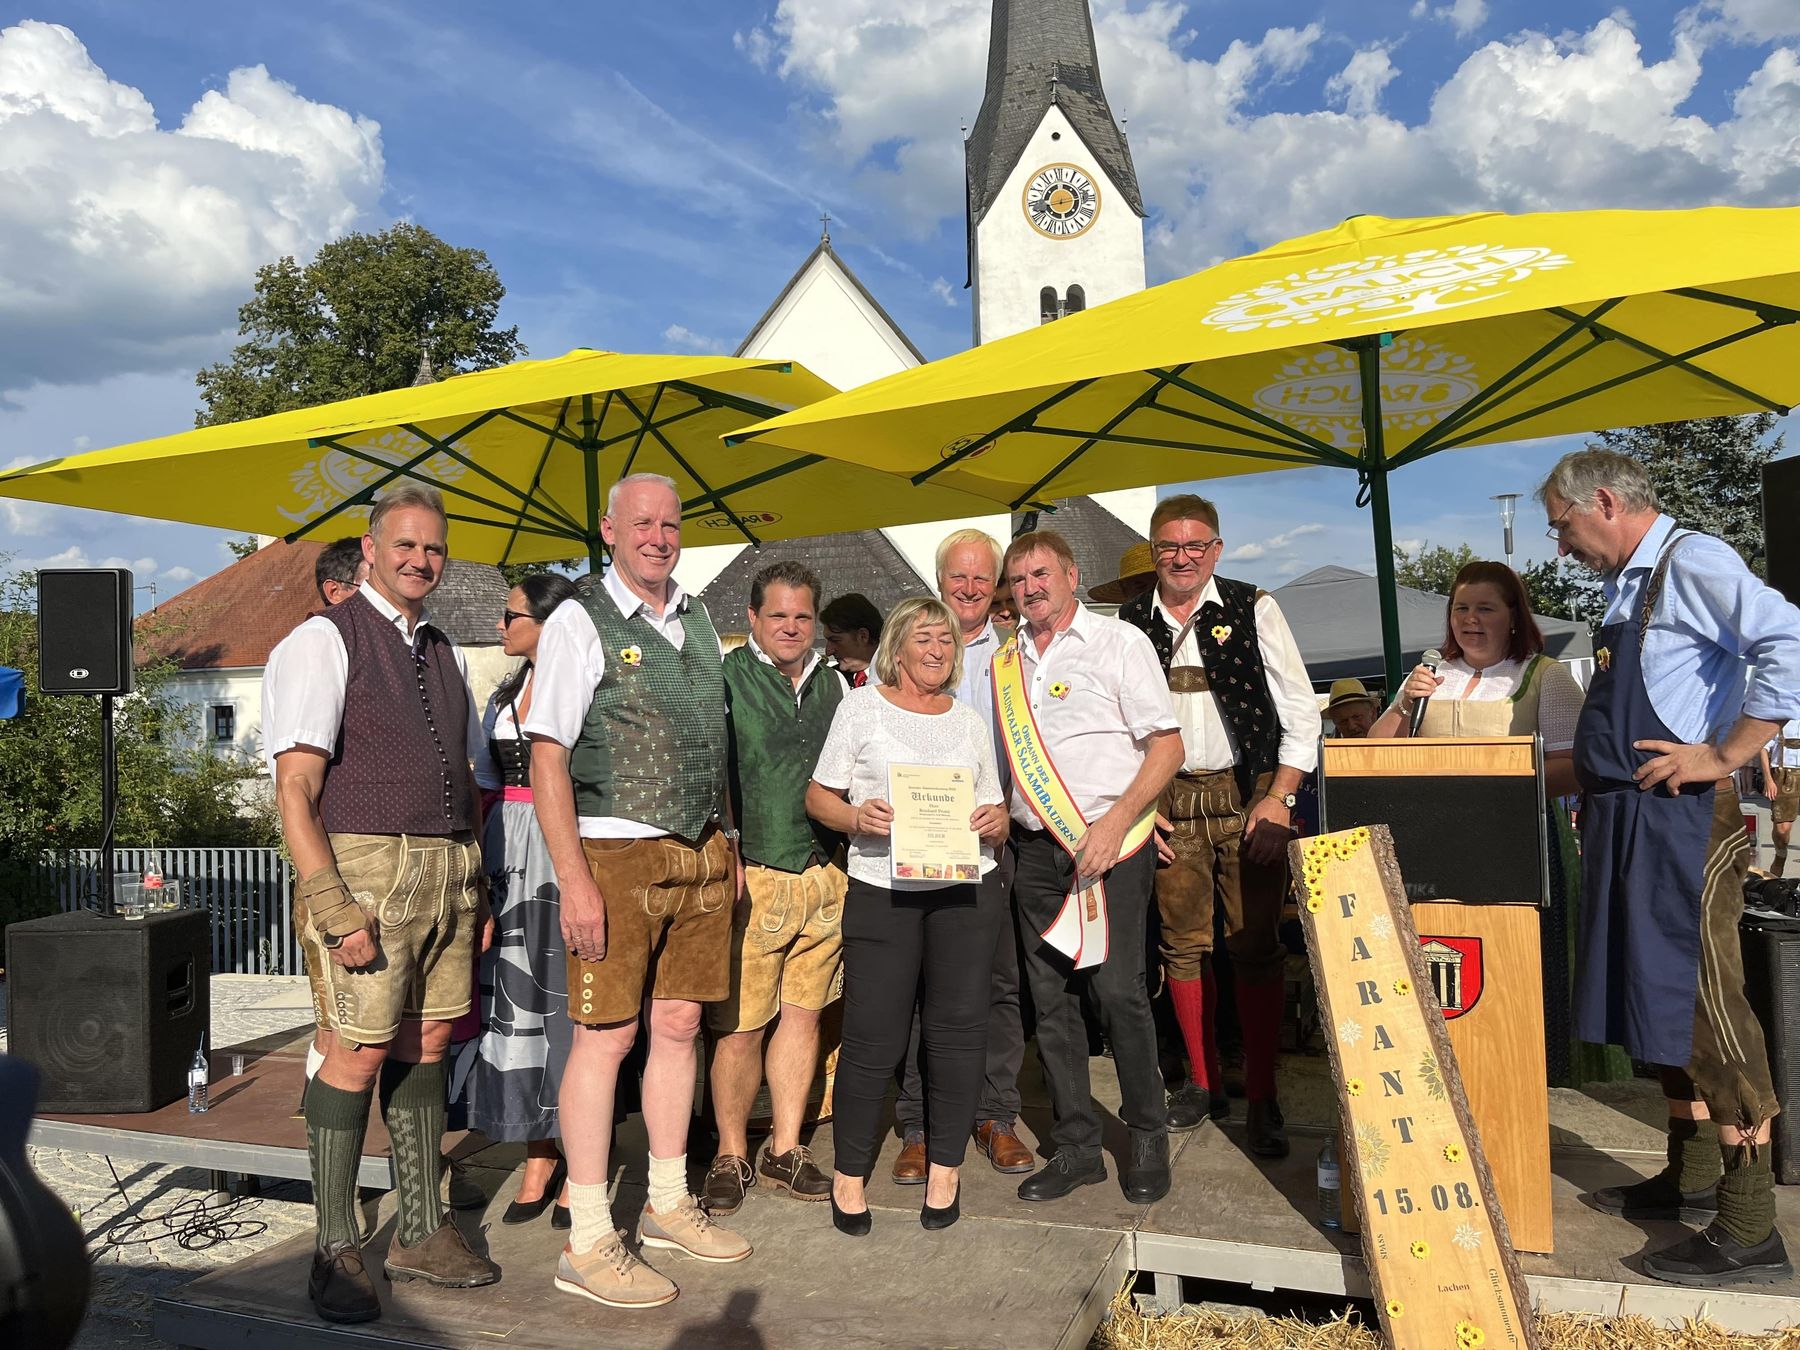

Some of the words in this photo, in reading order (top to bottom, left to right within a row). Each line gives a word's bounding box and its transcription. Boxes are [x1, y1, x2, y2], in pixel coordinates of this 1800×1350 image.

[1290, 255, 1506, 306] RAUCH
[1002, 684, 1022, 748] JAUNTALER
[1021, 724, 1040, 765] OBMANN
[1035, 764, 1050, 785] DER
[911, 791, 955, 803] Urkunde
[1338, 892, 1415, 1145] FARANT
[1377, 1233, 1387, 1260] SPASS
[1437, 1282, 1470, 1293] Lachen
[1488, 1267, 1516, 1343] Glücksmomente
